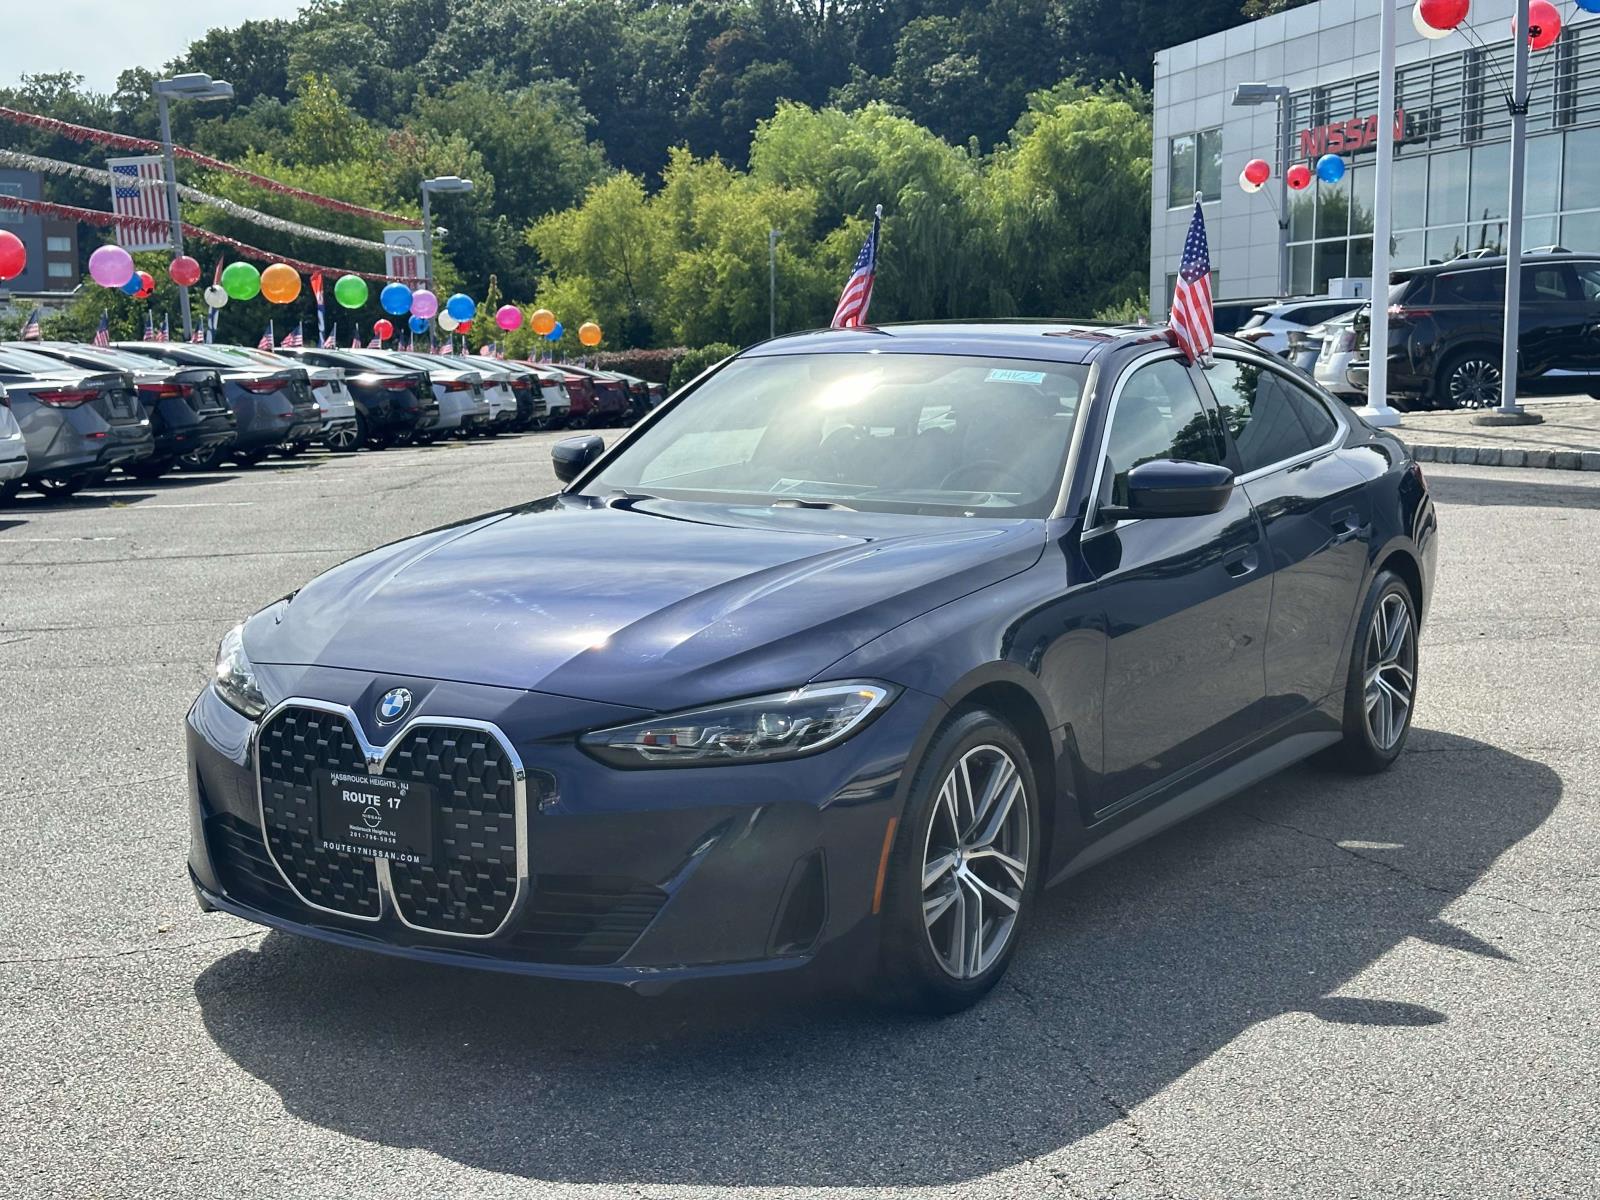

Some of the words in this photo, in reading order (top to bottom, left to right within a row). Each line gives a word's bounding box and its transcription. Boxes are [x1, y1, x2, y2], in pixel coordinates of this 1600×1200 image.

[1300, 108, 1405, 159] NISSAN
[330, 772, 369, 785] HASBROUCK
[400, 782, 409, 790] NJ
[342, 790, 381, 806] ROUTE
[387, 797, 401, 809] 17
[362, 813, 382, 821] NISSAN
[323, 841, 420, 863] ROUTE17NISSAN.COM
